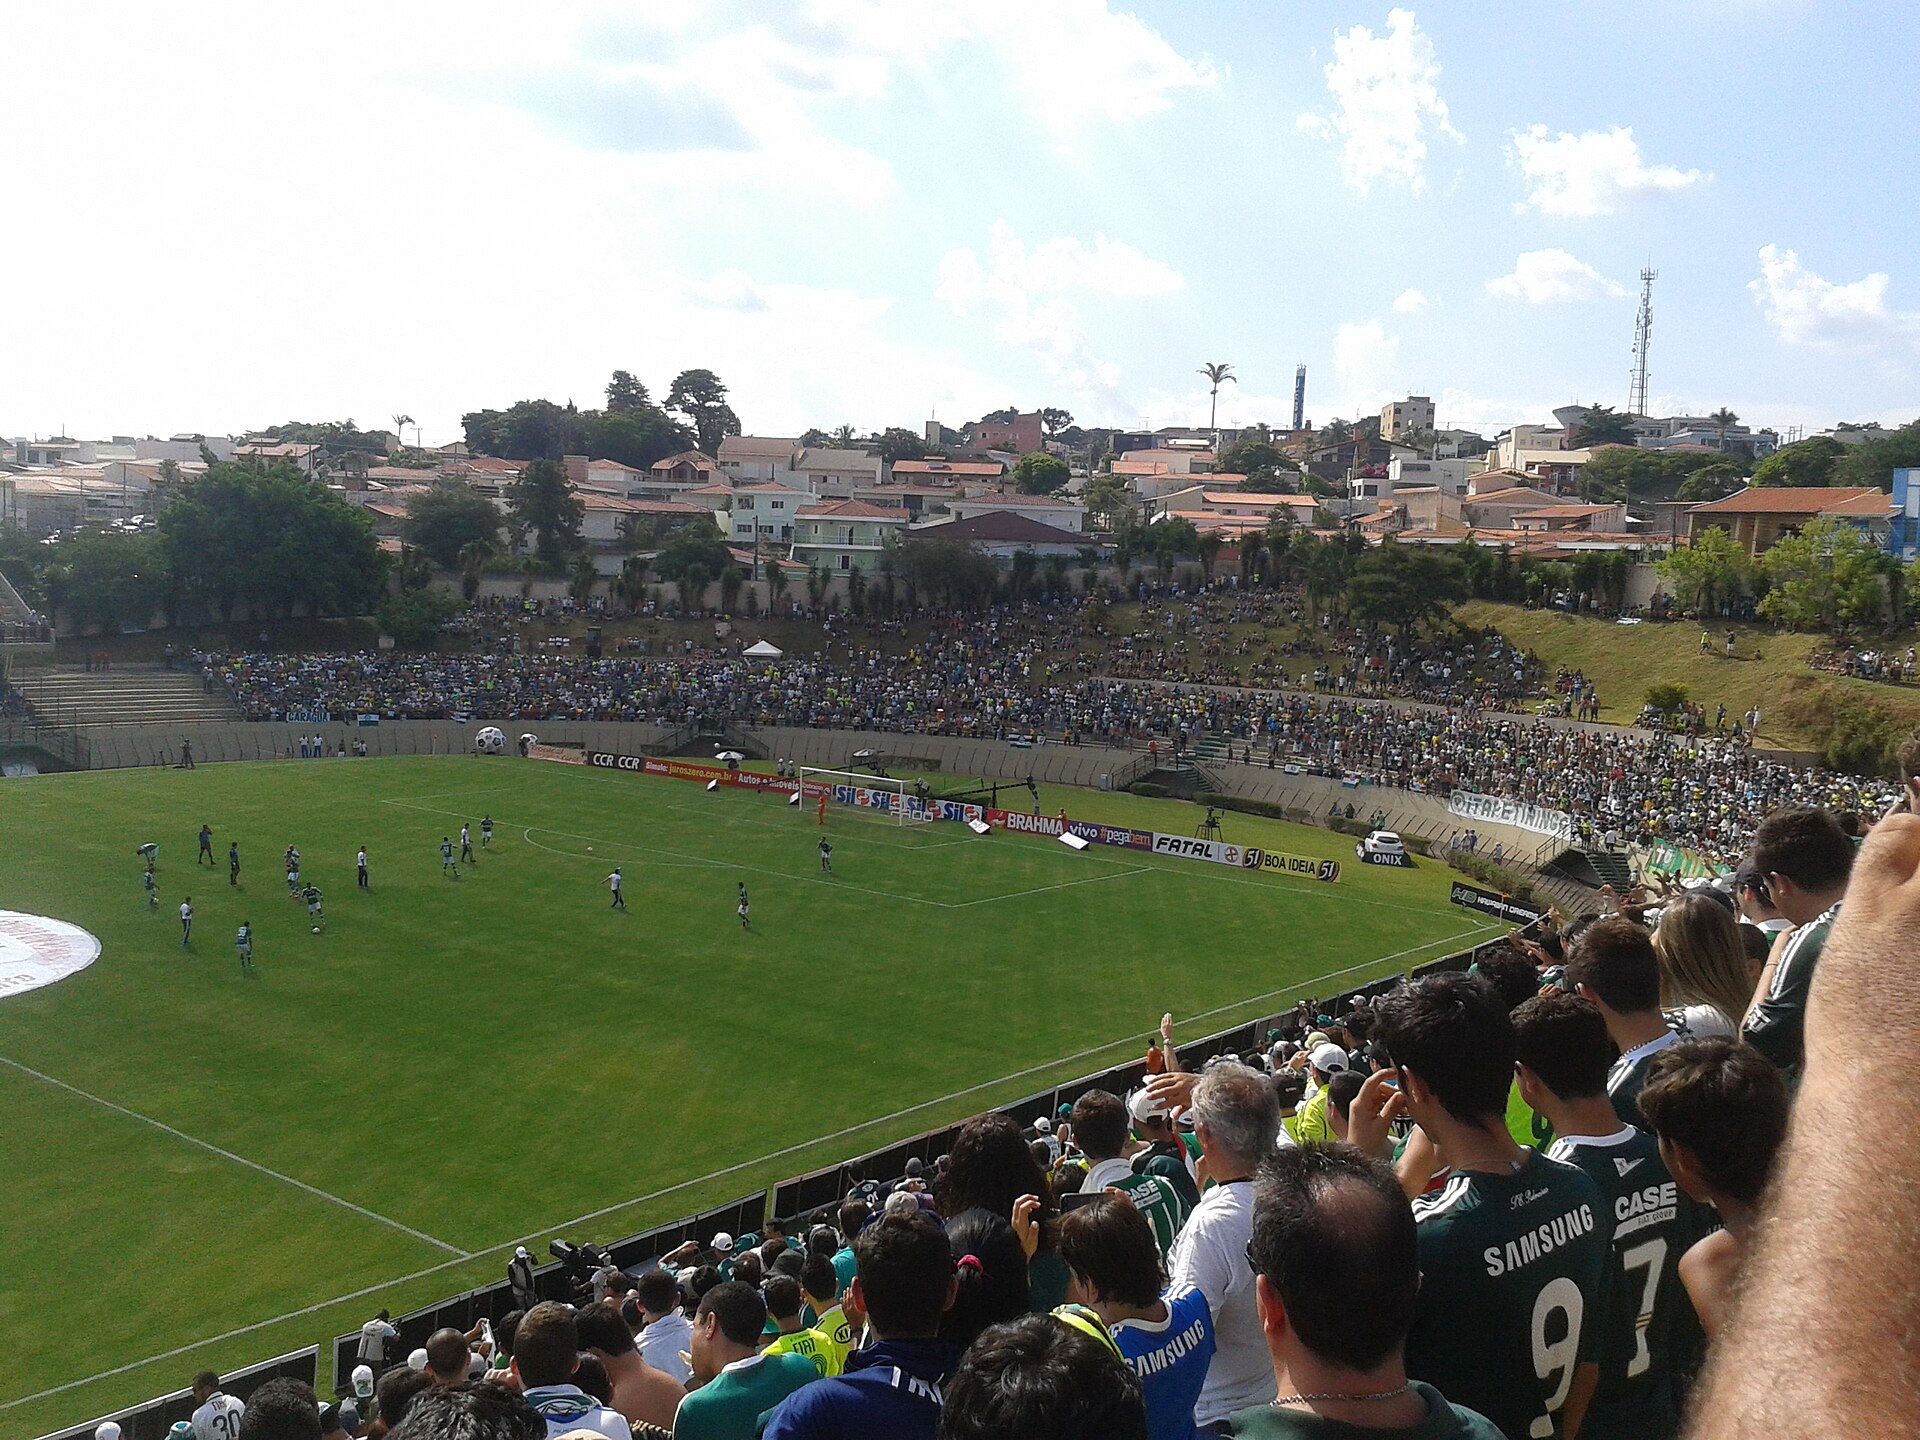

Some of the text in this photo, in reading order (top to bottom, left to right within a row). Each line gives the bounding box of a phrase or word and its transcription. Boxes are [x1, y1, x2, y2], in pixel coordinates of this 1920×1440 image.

[593, 753, 614, 767] CCR
[618, 756, 640, 770] CCR
[738, 772, 761, 785] Autos
[837, 786, 856, 805] Sil
[871, 791, 891, 811] Sil
[907, 796, 927, 813] Sil
[943, 802, 964, 822] Sil
[1006, 813, 1064, 835] BRAHMA
[1069, 823, 1151, 845] vivo #pegabem
[1156, 836, 1213, 858] FATAL
[1244, 849, 1336, 879] 51 BOA IDEIA 51
[1373, 853, 1402, 866] ONIX
[1509, 905, 1539, 920] DREAMS
[1125, 1179, 1159, 1202] ASE
[1614, 1181, 1678, 1221] CASE
[1483, 1203, 1594, 1277] SAMSUNG
[1623, 1237, 1668, 1377] 7
[793, 1337, 816, 1355] FIAT
[1530, 1277, 1584, 1438] 9
